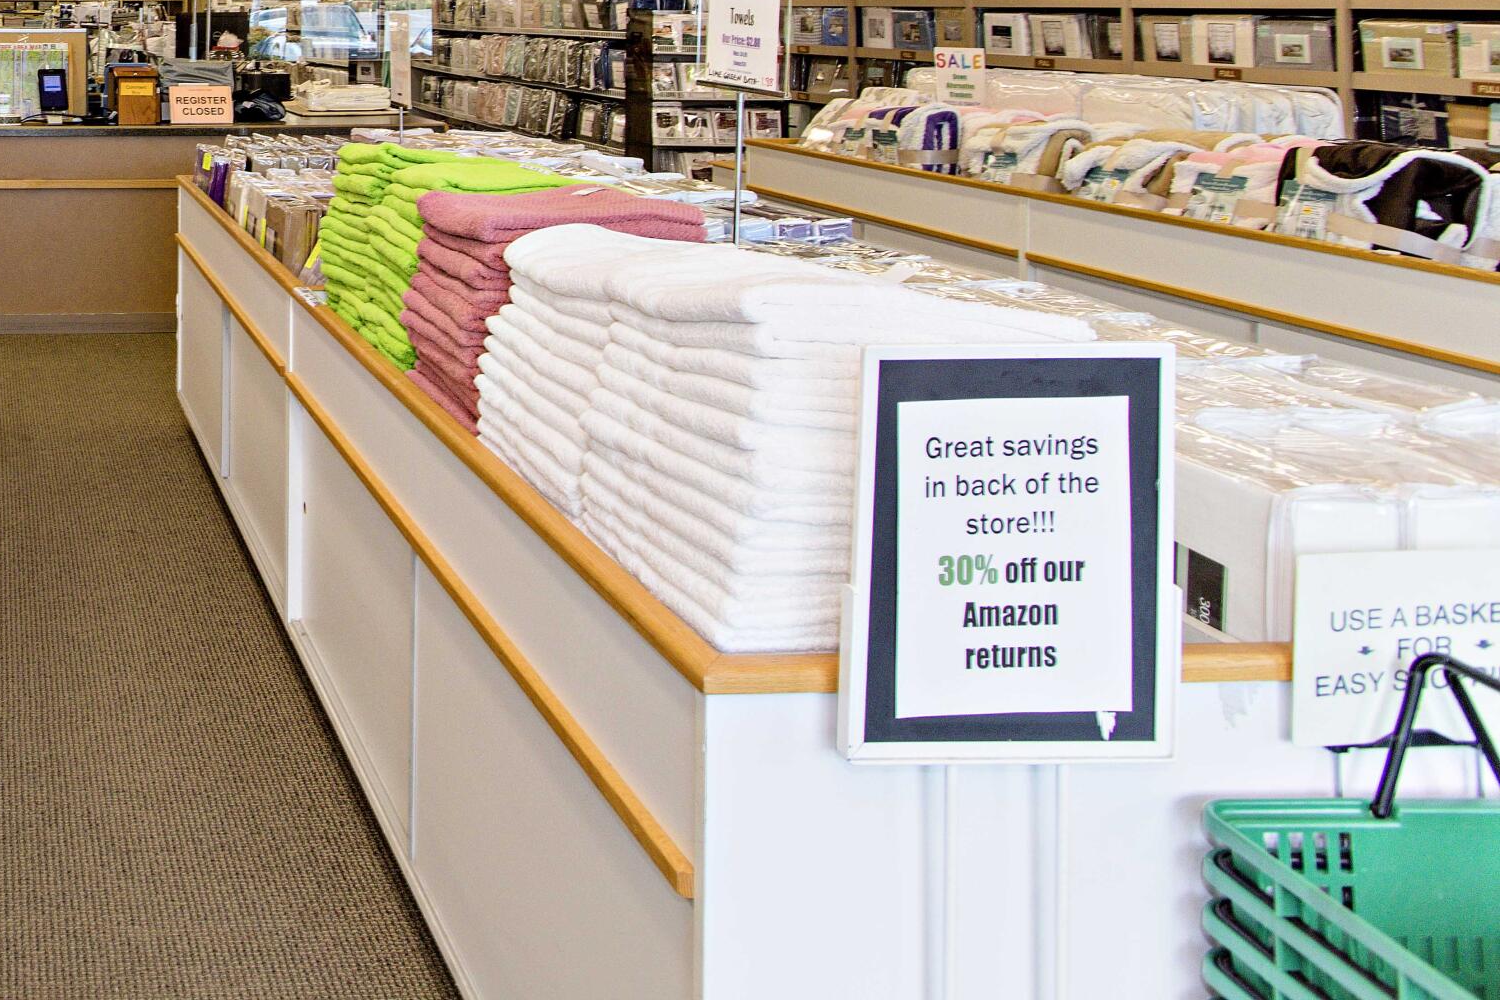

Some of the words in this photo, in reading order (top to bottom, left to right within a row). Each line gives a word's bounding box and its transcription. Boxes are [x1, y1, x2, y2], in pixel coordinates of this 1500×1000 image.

[730, 7, 755, 26] Towels
[936, 53, 982, 69] SALE
[708, 69, 722, 78] LIME
[723, 72, 743, 81] GREEN
[176, 96, 227, 105] REGISTER
[182, 107, 225, 116] CLOSED
[925, 436, 995, 459] Great
[1002, 434, 1099, 460] savings
[925, 476, 946, 498] in
[955, 473, 1016, 496] back
[1025, 472, 1050, 494] of
[1058, 472, 1100, 494] the
[966, 510, 1055, 535] store!!!
[938, 554, 999, 586] 30%
[1005, 557, 1038, 583] off
[1043, 560, 1086, 582] our
[963, 602, 1059, 627] Amazon
[1330, 608, 1383, 632] USE
[1390, 607, 1408, 627] A
[965, 644, 1057, 669] returns
[1397, 636, 1452, 659] FOR
[1316, 672, 1385, 697] EASY
